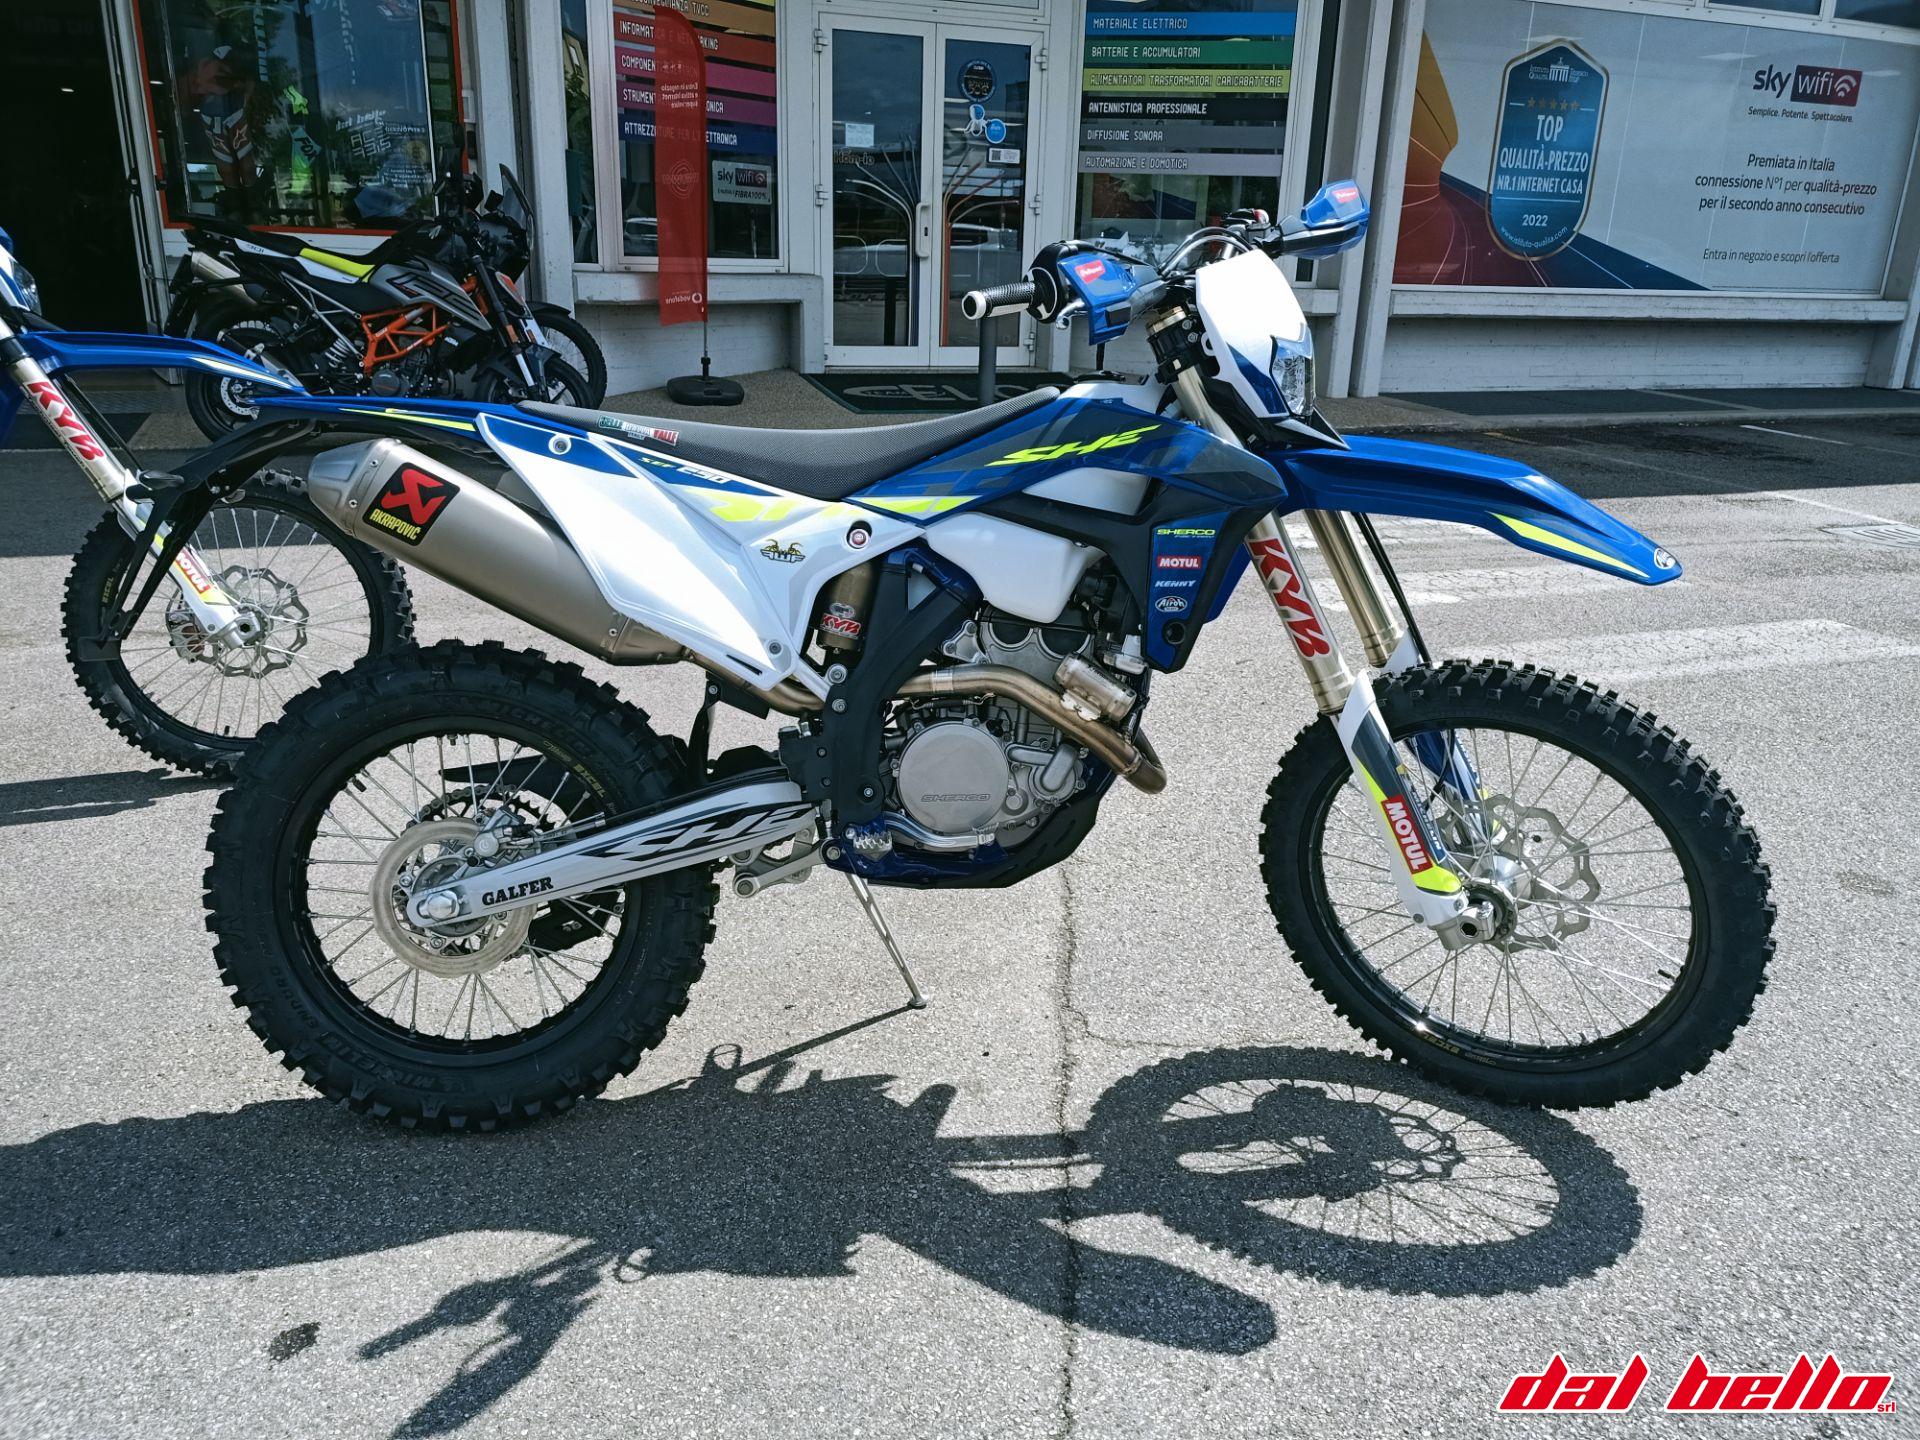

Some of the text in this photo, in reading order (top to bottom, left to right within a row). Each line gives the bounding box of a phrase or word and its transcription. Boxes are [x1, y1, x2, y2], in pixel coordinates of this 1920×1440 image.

[691, 2, 710, 16] TVCC
[1093, 18, 1188, 29] MATERIALE ELETTRICO
[1091, 46, 1201, 57] BATTERIE E ACCUMULATORI
[1090, 74, 1283, 87] ALIMENTATORI TRASFORMATORI CARICABATTERIE
[1753, 64, 1834, 99] sky wifi
[1089, 102, 1208, 114] ANTENNISTICA PROFESSIONALE
[1748, 106, 1854, 123] Semplice. Potente. Spettacolare.
[1087, 130, 1163, 141] DIFFUSIONE SONORA
[1536, 115, 1564, 142] TOP
[1085, 157, 1188, 169] AUTOMAZIONE E DOMOTICA
[1500, 144, 1589, 173] QUALITÀ-PREZZO
[1747, 153, 1835, 171] Premiata in Italia
[717, 168, 734, 184] sky
[736, 171, 754, 184] wifi
[1516, 176, 1560, 192] INTERNET
[1561, 179, 1583, 194] CASA
[1695, 174, 1763, 189] connessione
[1783, 179, 1803, 194] per
[1803, 179, 1877, 196] qualità-prezzo
[1699, 196, 1865, 215] per il secondo anno consecutivo
[1522, 214, 1549, 227] 2022
[1703, 248, 1840, 264] Entra in negozio e scopri l'offerta
[27, 381, 105, 461] KYB
[1157, 528, 1216, 536] SHERCO
[1159, 557, 1199, 568] MOTUL
[1155, 580, 1197, 588] KENNY
[1248, 538, 1332, 660] KYB
[821, 614, 861, 635] KYB
[921, 793, 991, 803] SHERCO
[1386, 801, 1428, 870] MOTUL
[482, 876, 554, 907] GALFER
